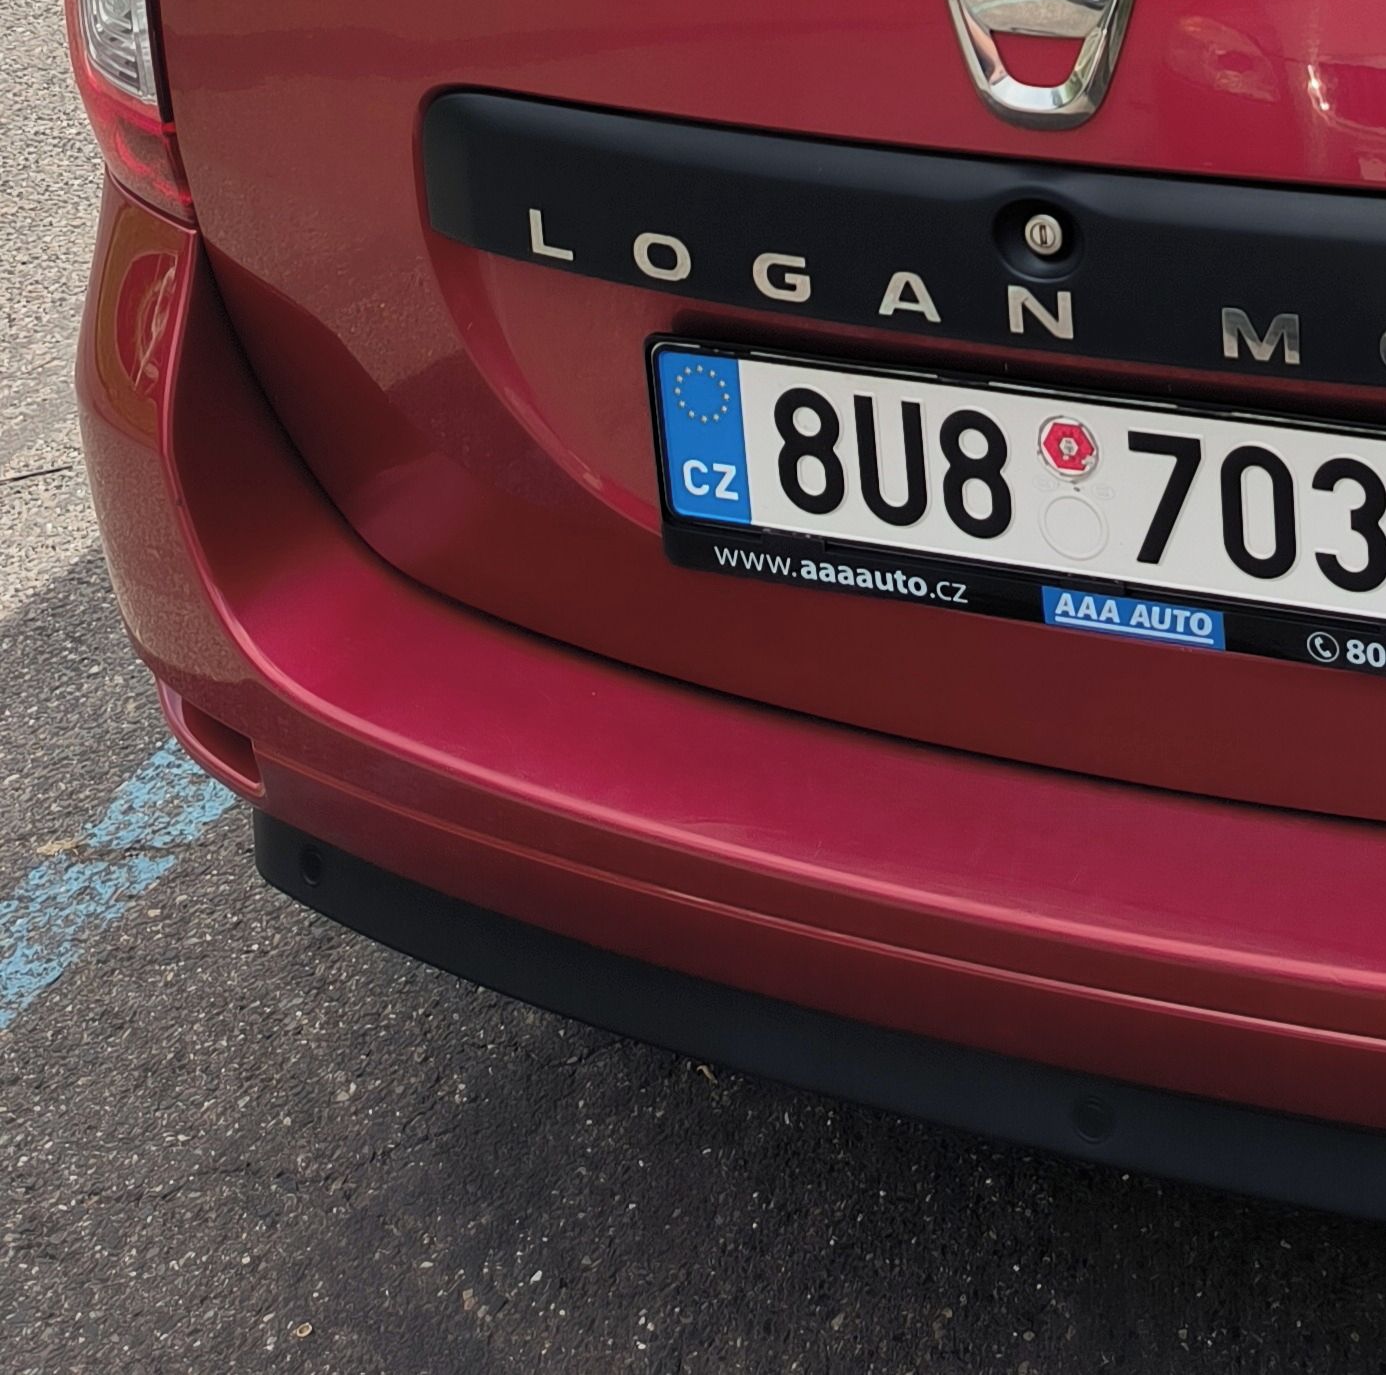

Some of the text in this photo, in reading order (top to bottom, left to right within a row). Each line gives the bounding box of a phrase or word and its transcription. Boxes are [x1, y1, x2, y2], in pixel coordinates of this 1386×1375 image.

[528, 208, 1074, 340] LOGAN
[683, 459, 739, 501] CZ
[774, 387, 1012, 539] 8U8
[714, 545, 969, 604] www.aaaauto.cz
[1055, 592, 1213, 637] AAA AUTO
